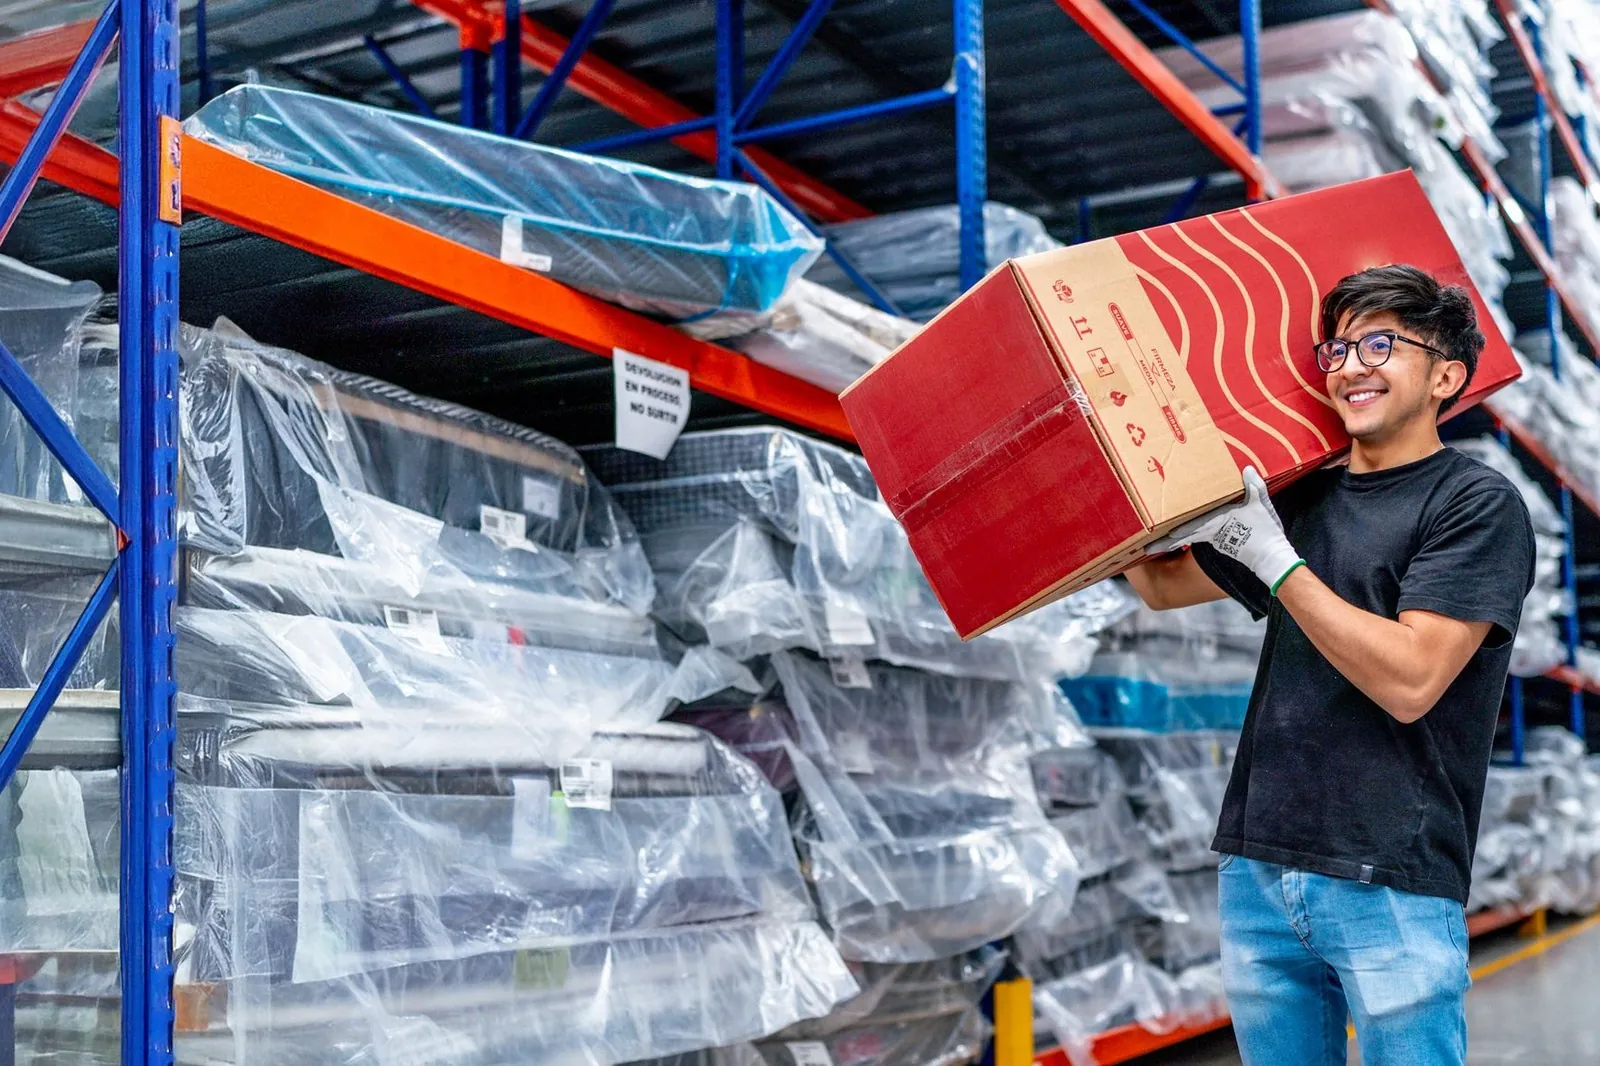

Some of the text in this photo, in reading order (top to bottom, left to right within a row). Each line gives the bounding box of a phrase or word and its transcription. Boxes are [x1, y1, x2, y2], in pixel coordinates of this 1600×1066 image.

[1113, 309, 1130, 335] SUAVE
[1139, 360, 1155, 386] MEDIA
[1151, 348, 1176, 392] FIRMEZA
[625, 381, 639, 393] EN
[630, 402, 645, 415] NO
[1167, 411, 1183, 437] FIRME
